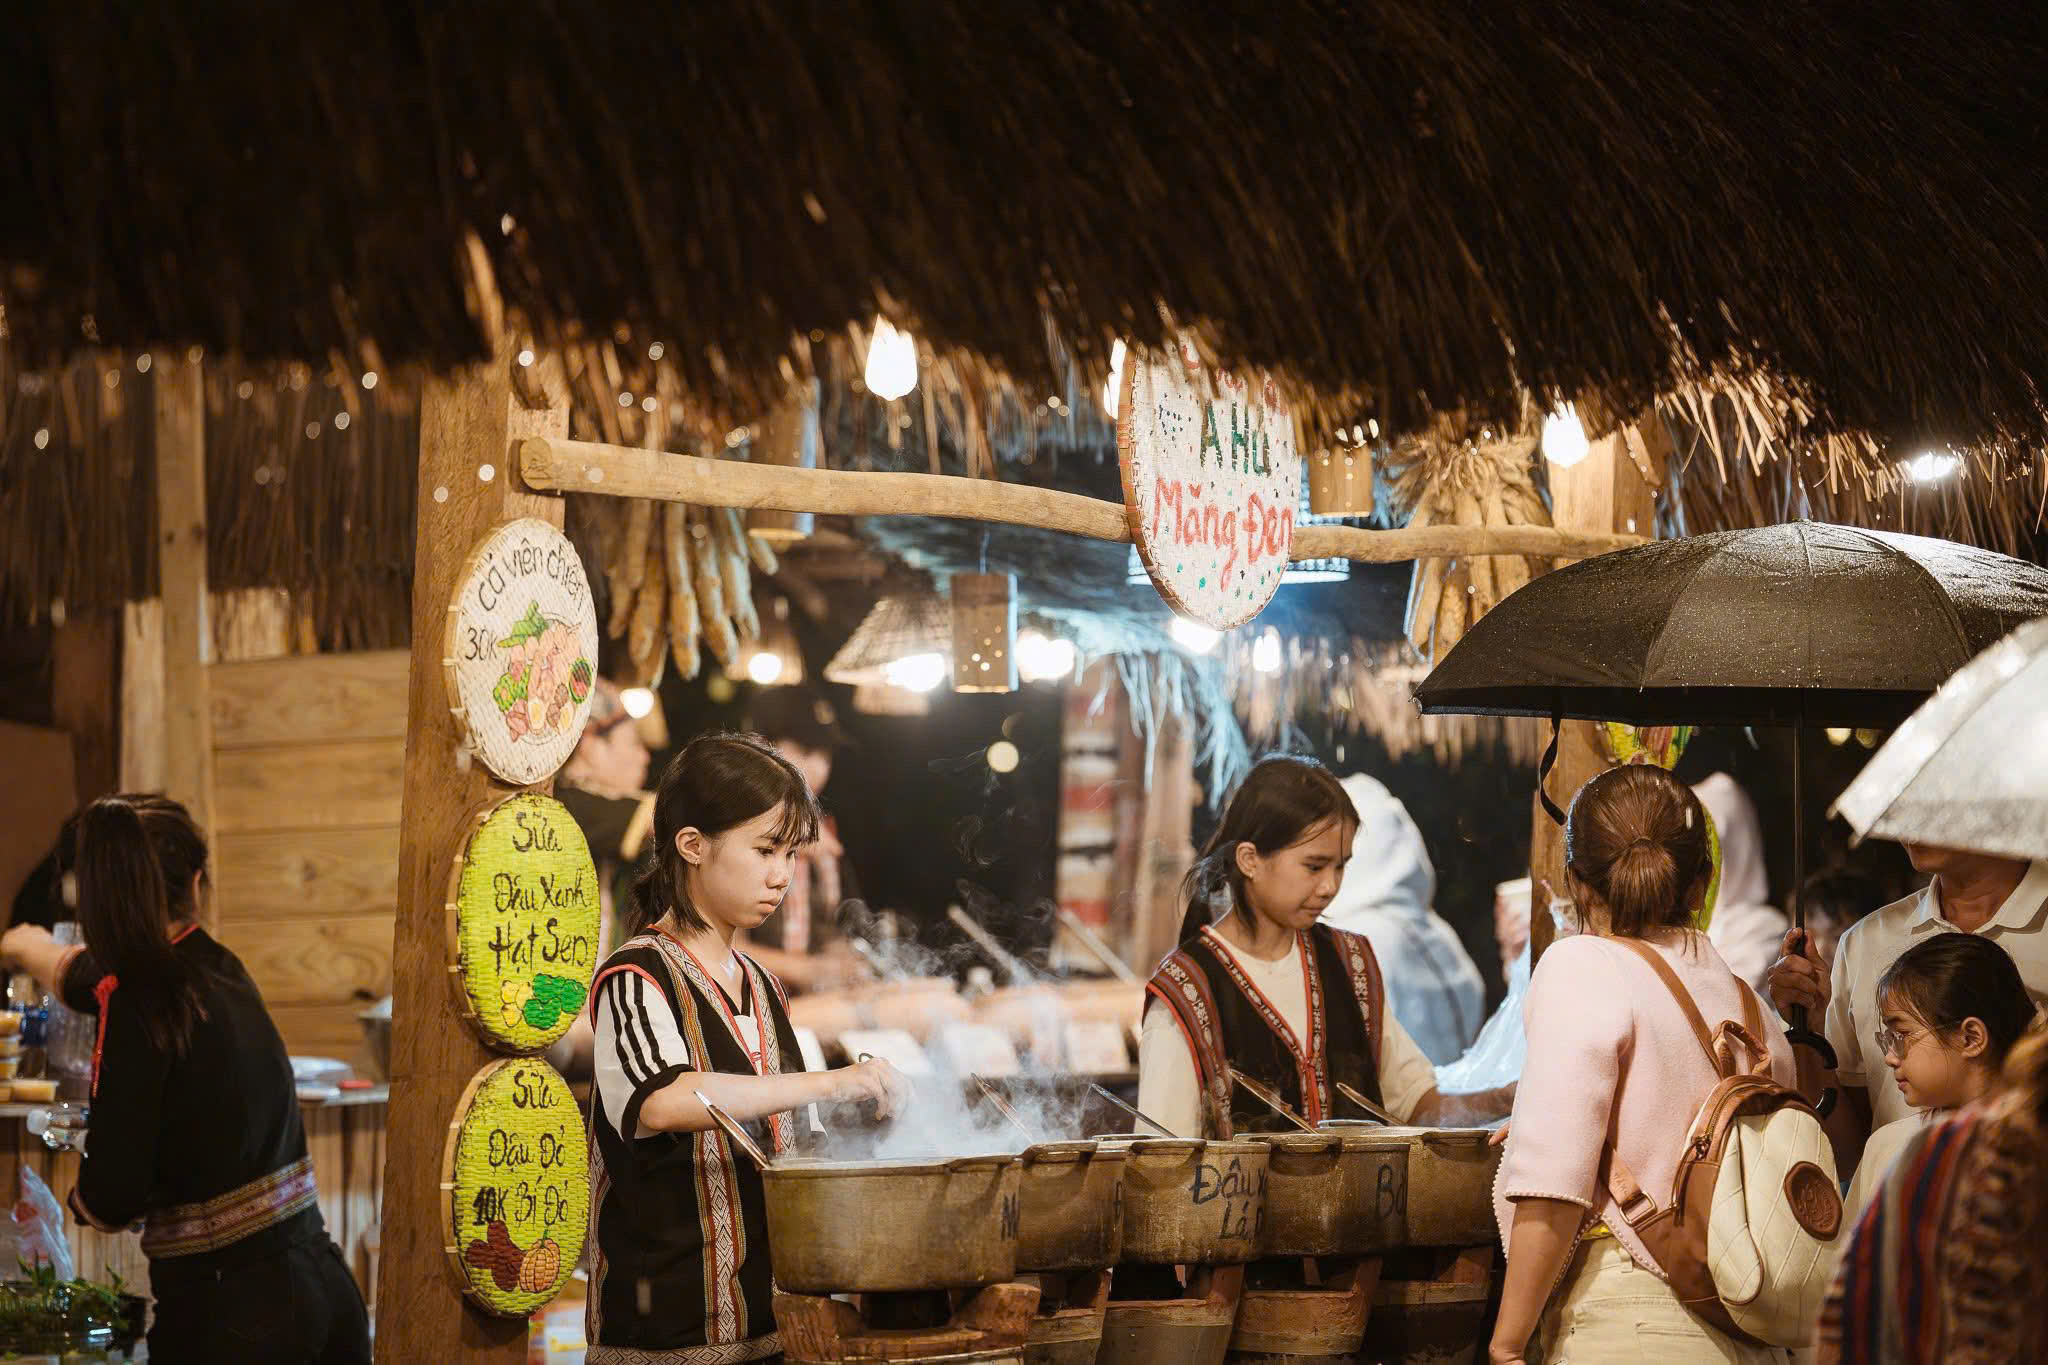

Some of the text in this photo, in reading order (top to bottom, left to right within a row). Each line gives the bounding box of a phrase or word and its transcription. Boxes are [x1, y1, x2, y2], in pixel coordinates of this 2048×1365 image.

[1242, 491, 1294, 566] Đen
[540, 868, 592, 912] Xanh
[488, 917, 588, 977] Hạt Sen
[512, 1069, 561, 1109] Sữa
